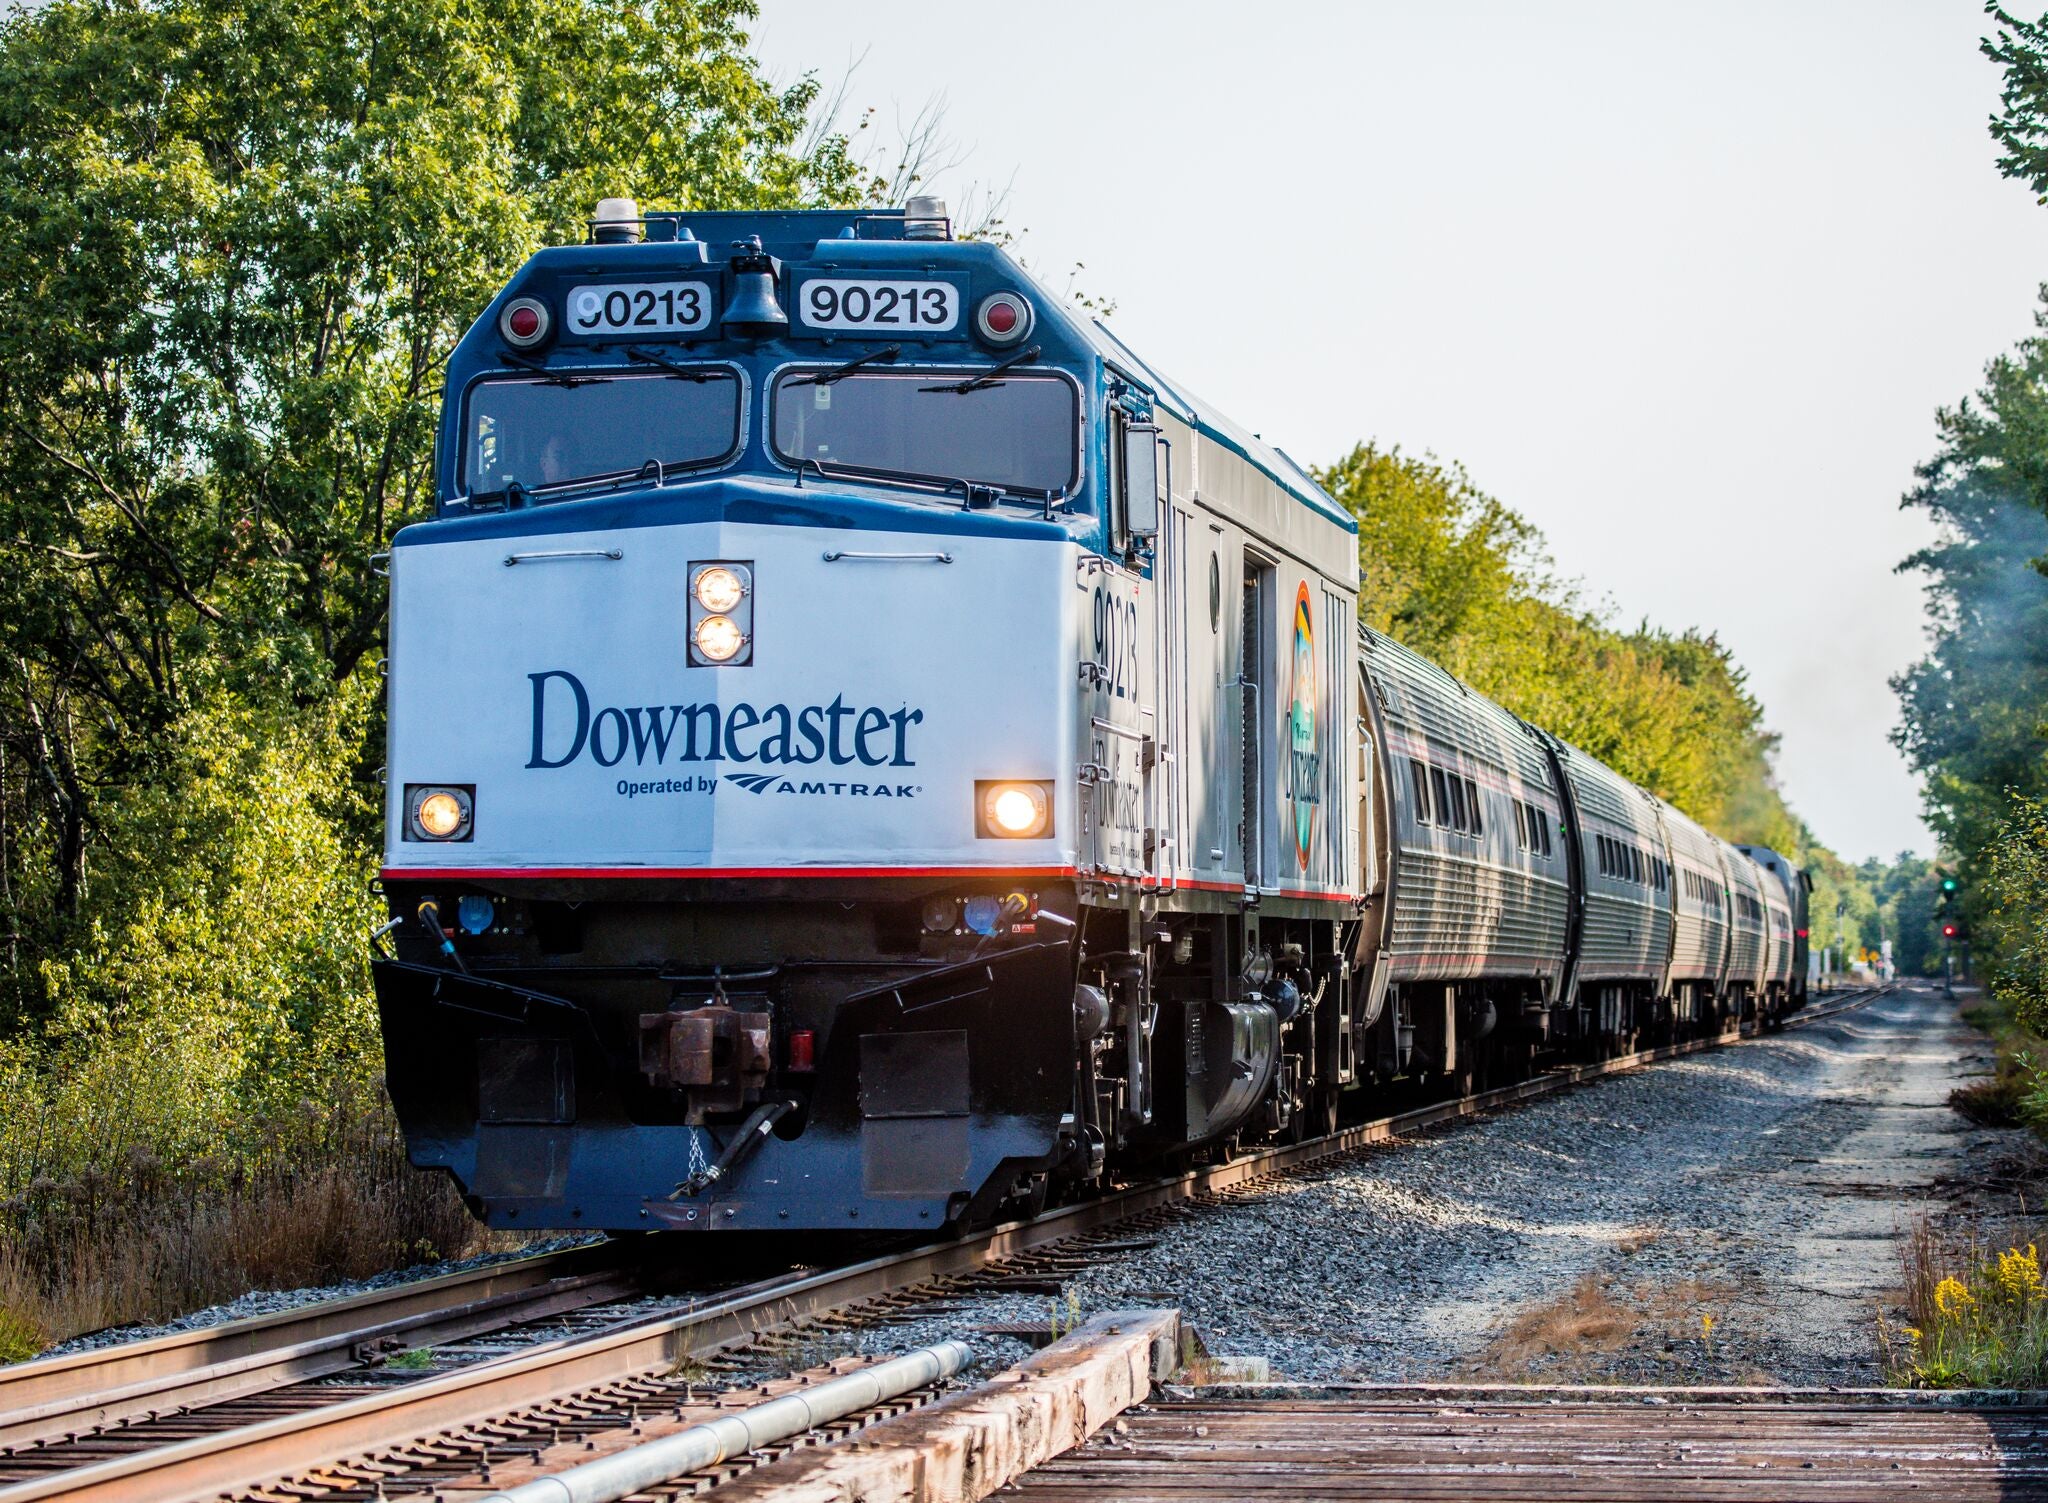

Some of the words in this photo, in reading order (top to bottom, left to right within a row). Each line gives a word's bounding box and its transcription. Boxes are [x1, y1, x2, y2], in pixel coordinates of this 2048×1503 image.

[577, 288, 702, 329] 90213
[810, 285, 949, 325] 90213
[1094, 585, 1138, 705] 90213
[525, 670, 924, 769] Downeaster
[616, 776, 693, 799] Operated
[697, 775, 718, 796] by
